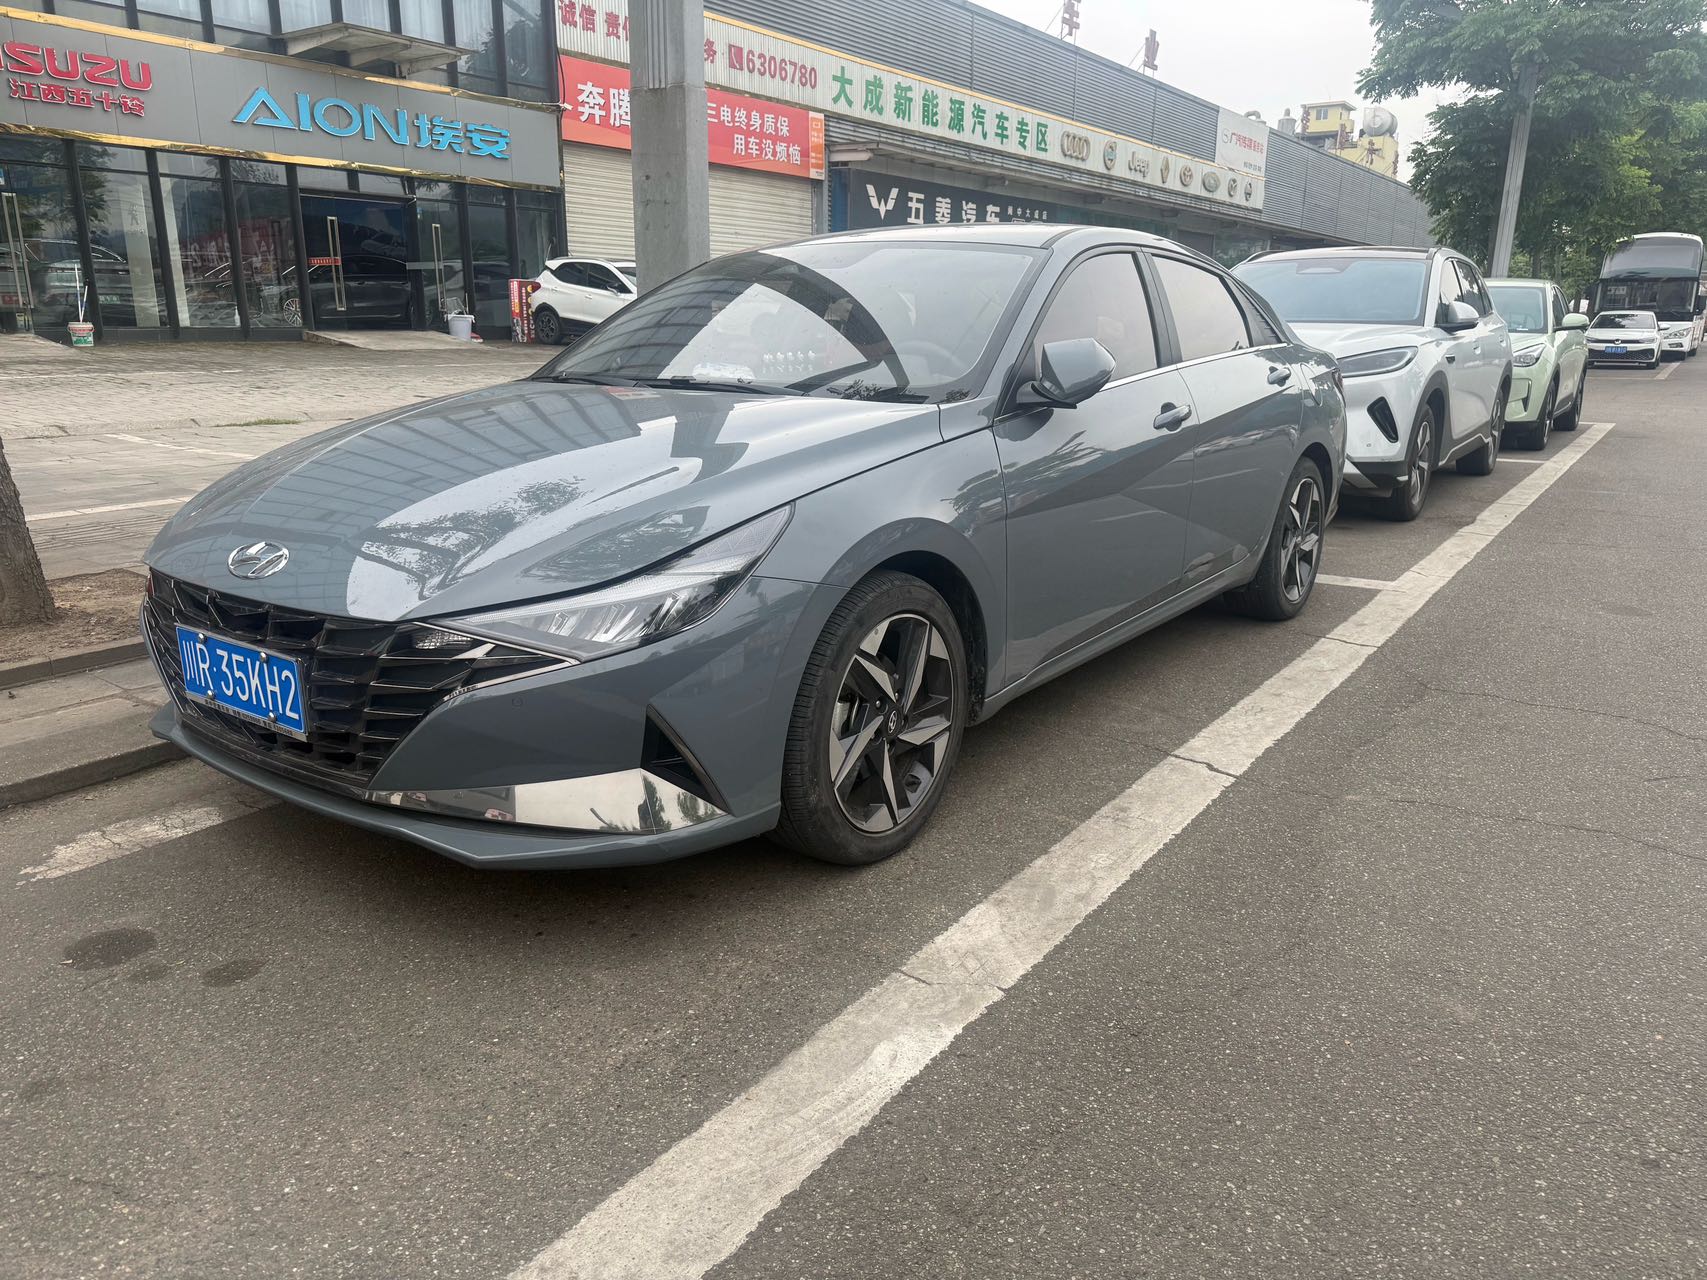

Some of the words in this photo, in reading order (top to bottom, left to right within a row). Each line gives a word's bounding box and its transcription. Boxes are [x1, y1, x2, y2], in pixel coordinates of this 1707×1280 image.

[559, 2, 596, 33] 诚信
[746, 49, 818, 90] 6306780
[9, 77, 145, 117] 江西五十铃
[832, 66, 1048, 153] 大成新能源汽车专区
[232, 86, 409, 146] AION
[413, 112, 511, 159] 埃安
[707, 102, 790, 138] 三电终身质保
[733, 133, 801, 166] 用车没烦恼
[1128, 150, 1150, 178] Jeep
[907, 191, 1000, 224] 五菱汽车
